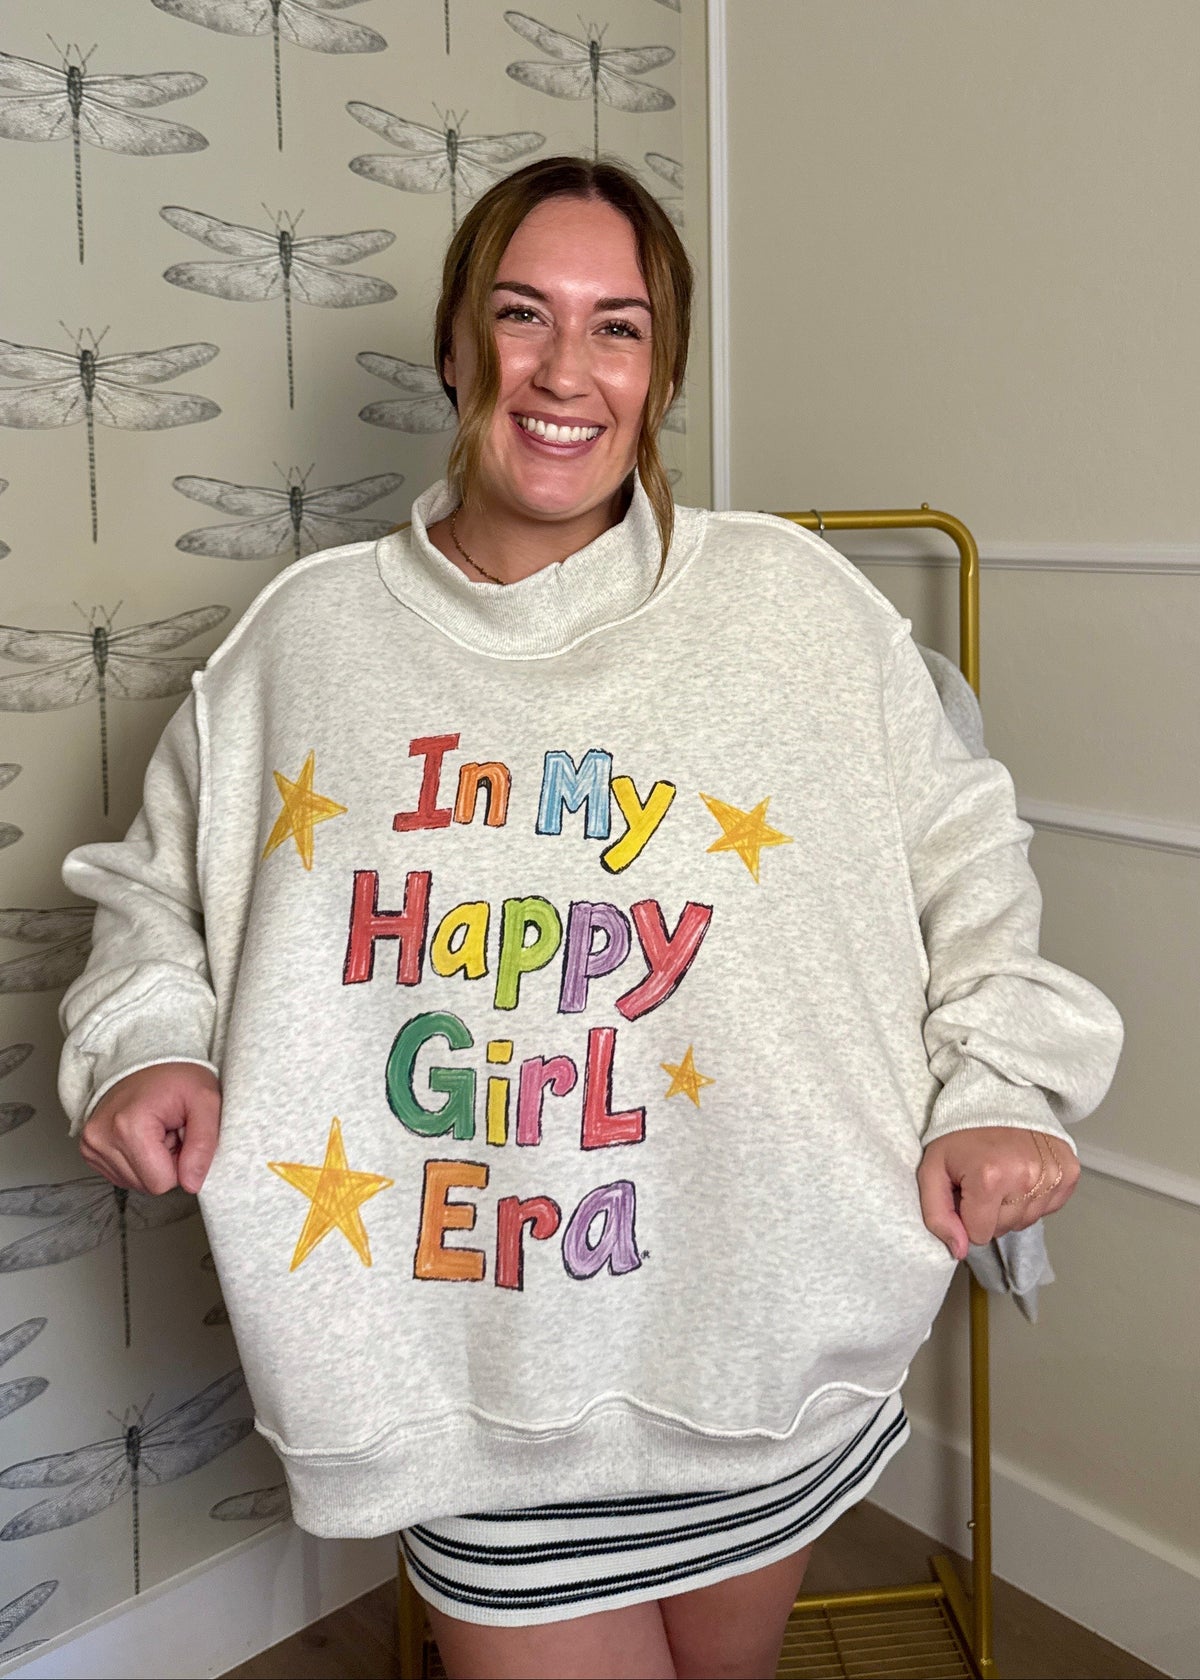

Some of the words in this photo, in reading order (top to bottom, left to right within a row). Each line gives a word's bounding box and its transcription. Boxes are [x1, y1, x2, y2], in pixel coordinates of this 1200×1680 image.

[393, 732, 512, 832] In
[535, 749, 676, 874] My
[342, 870, 714, 1021] Happy
[412, 1158, 643, 1291] Era
